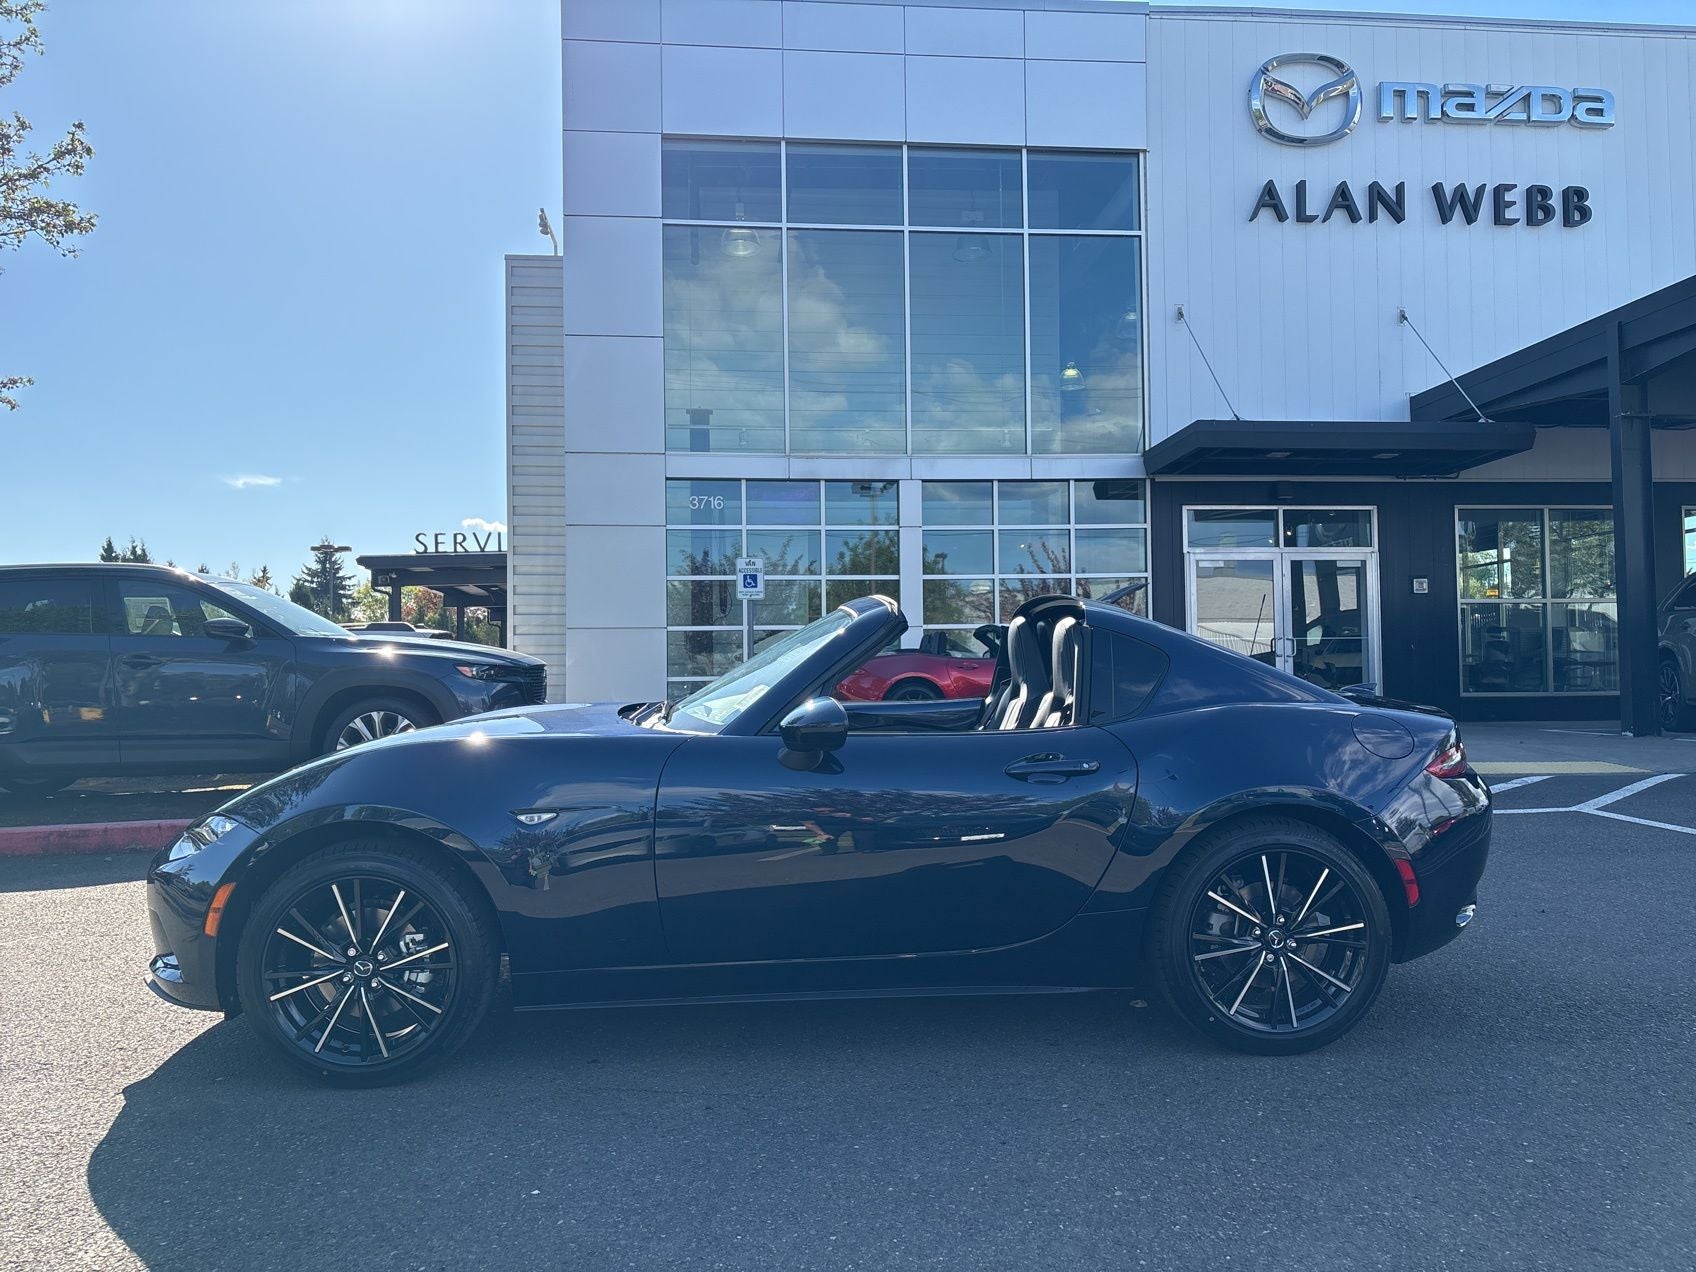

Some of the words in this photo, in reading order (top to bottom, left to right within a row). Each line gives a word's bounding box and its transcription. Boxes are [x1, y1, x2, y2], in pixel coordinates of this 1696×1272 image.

[1248, 178, 1407, 225] ALAN
[1431, 180, 1594, 228] WEBB
[689, 495, 724, 510] 3716
[414, 531, 502, 554] SERVI
